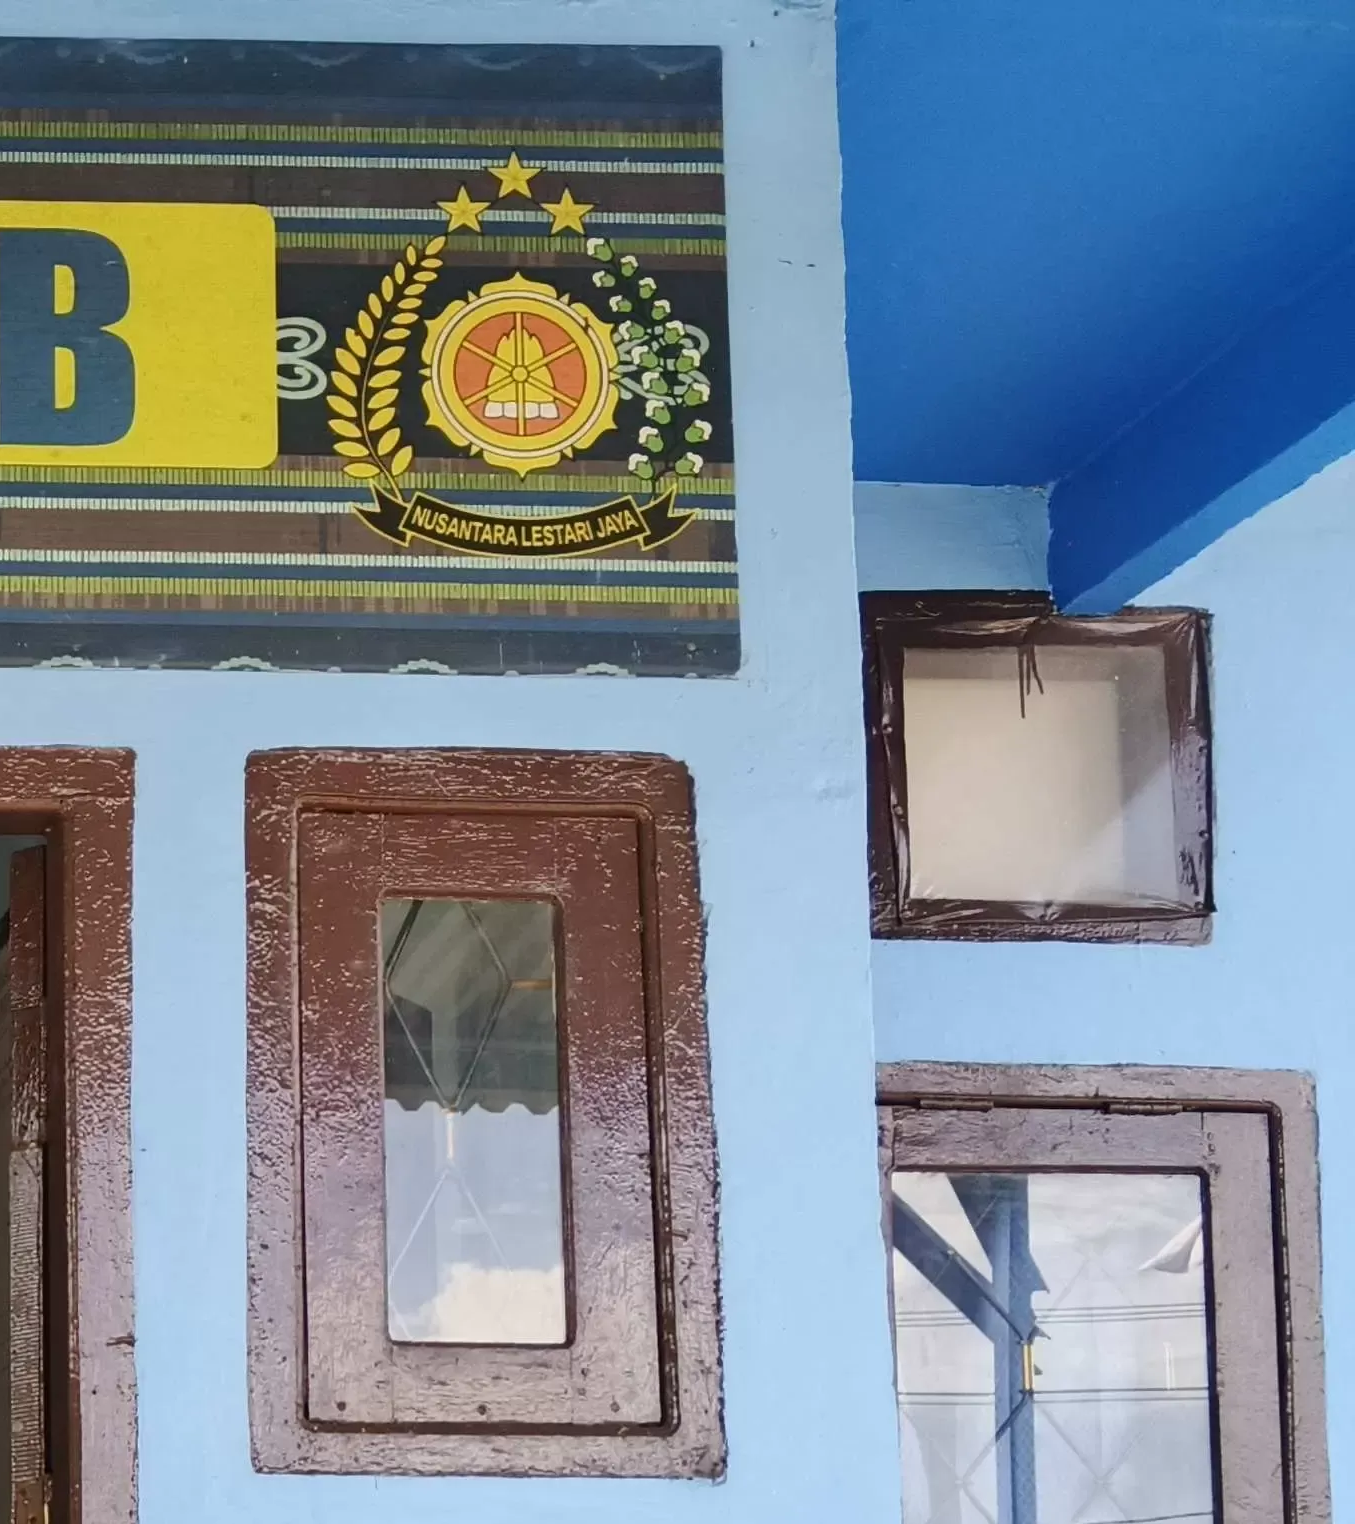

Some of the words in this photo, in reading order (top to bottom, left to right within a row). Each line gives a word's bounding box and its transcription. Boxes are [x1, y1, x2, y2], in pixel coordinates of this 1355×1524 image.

[410, 505, 518, 546] NUSANTARA
[521, 521, 594, 547] LESTARI
[594, 509, 639, 539] JAYA
